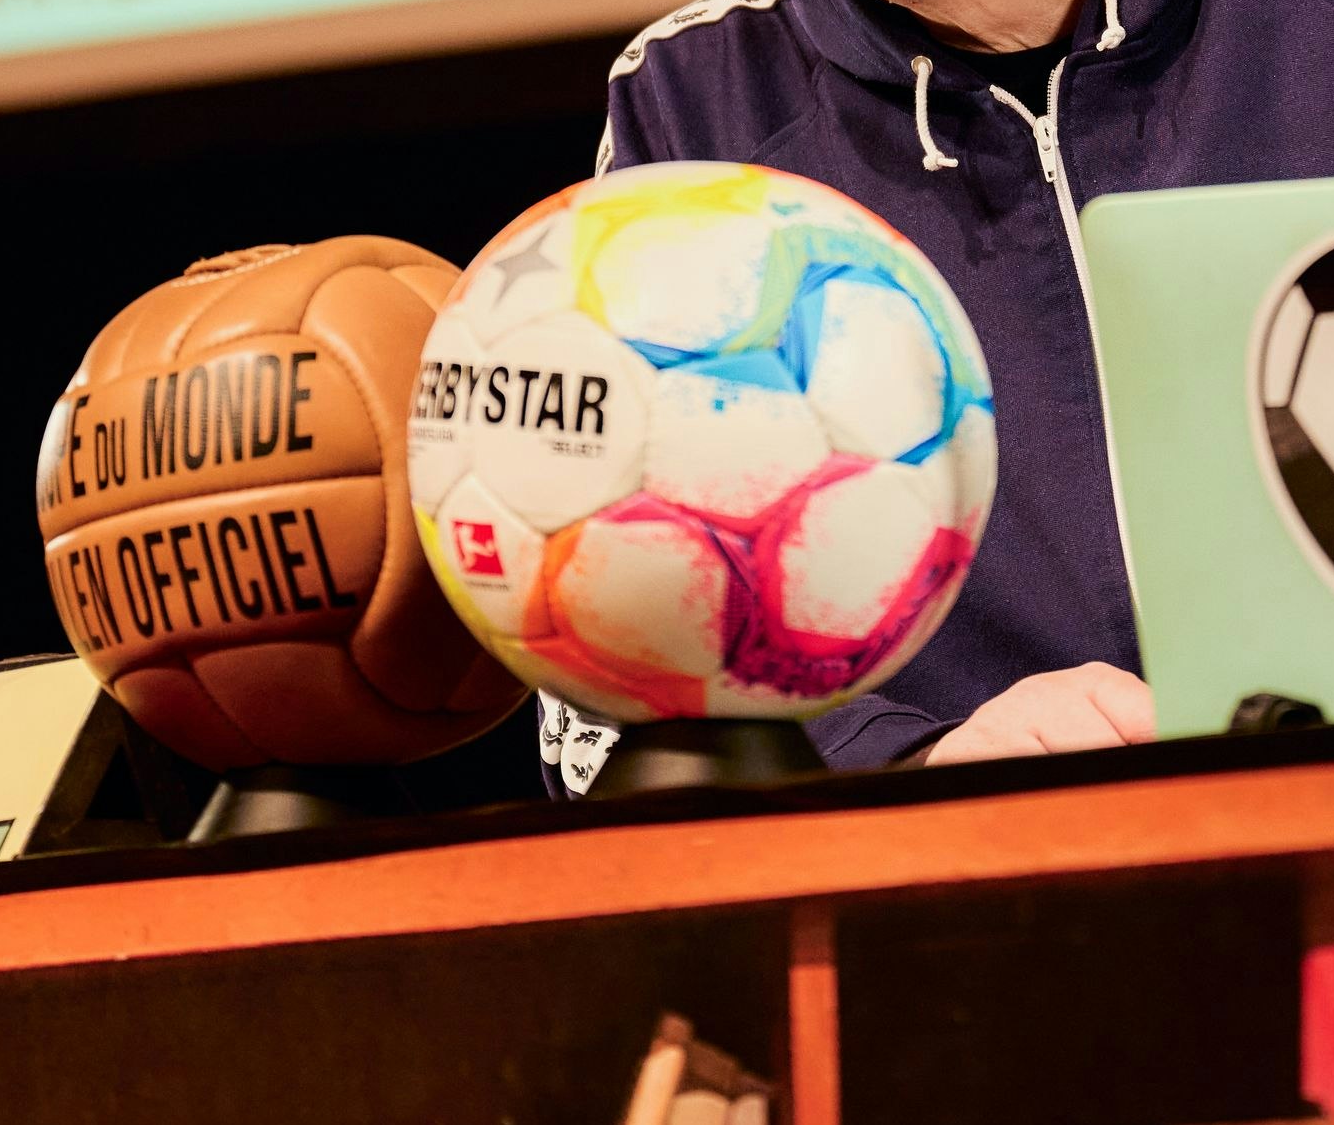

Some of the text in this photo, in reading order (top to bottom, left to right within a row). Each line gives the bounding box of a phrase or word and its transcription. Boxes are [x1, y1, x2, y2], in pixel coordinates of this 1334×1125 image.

[94, 417, 126, 492] DU
[141, 350, 318, 482] MONDE
[115, 507, 358, 641] OFFICIEL
